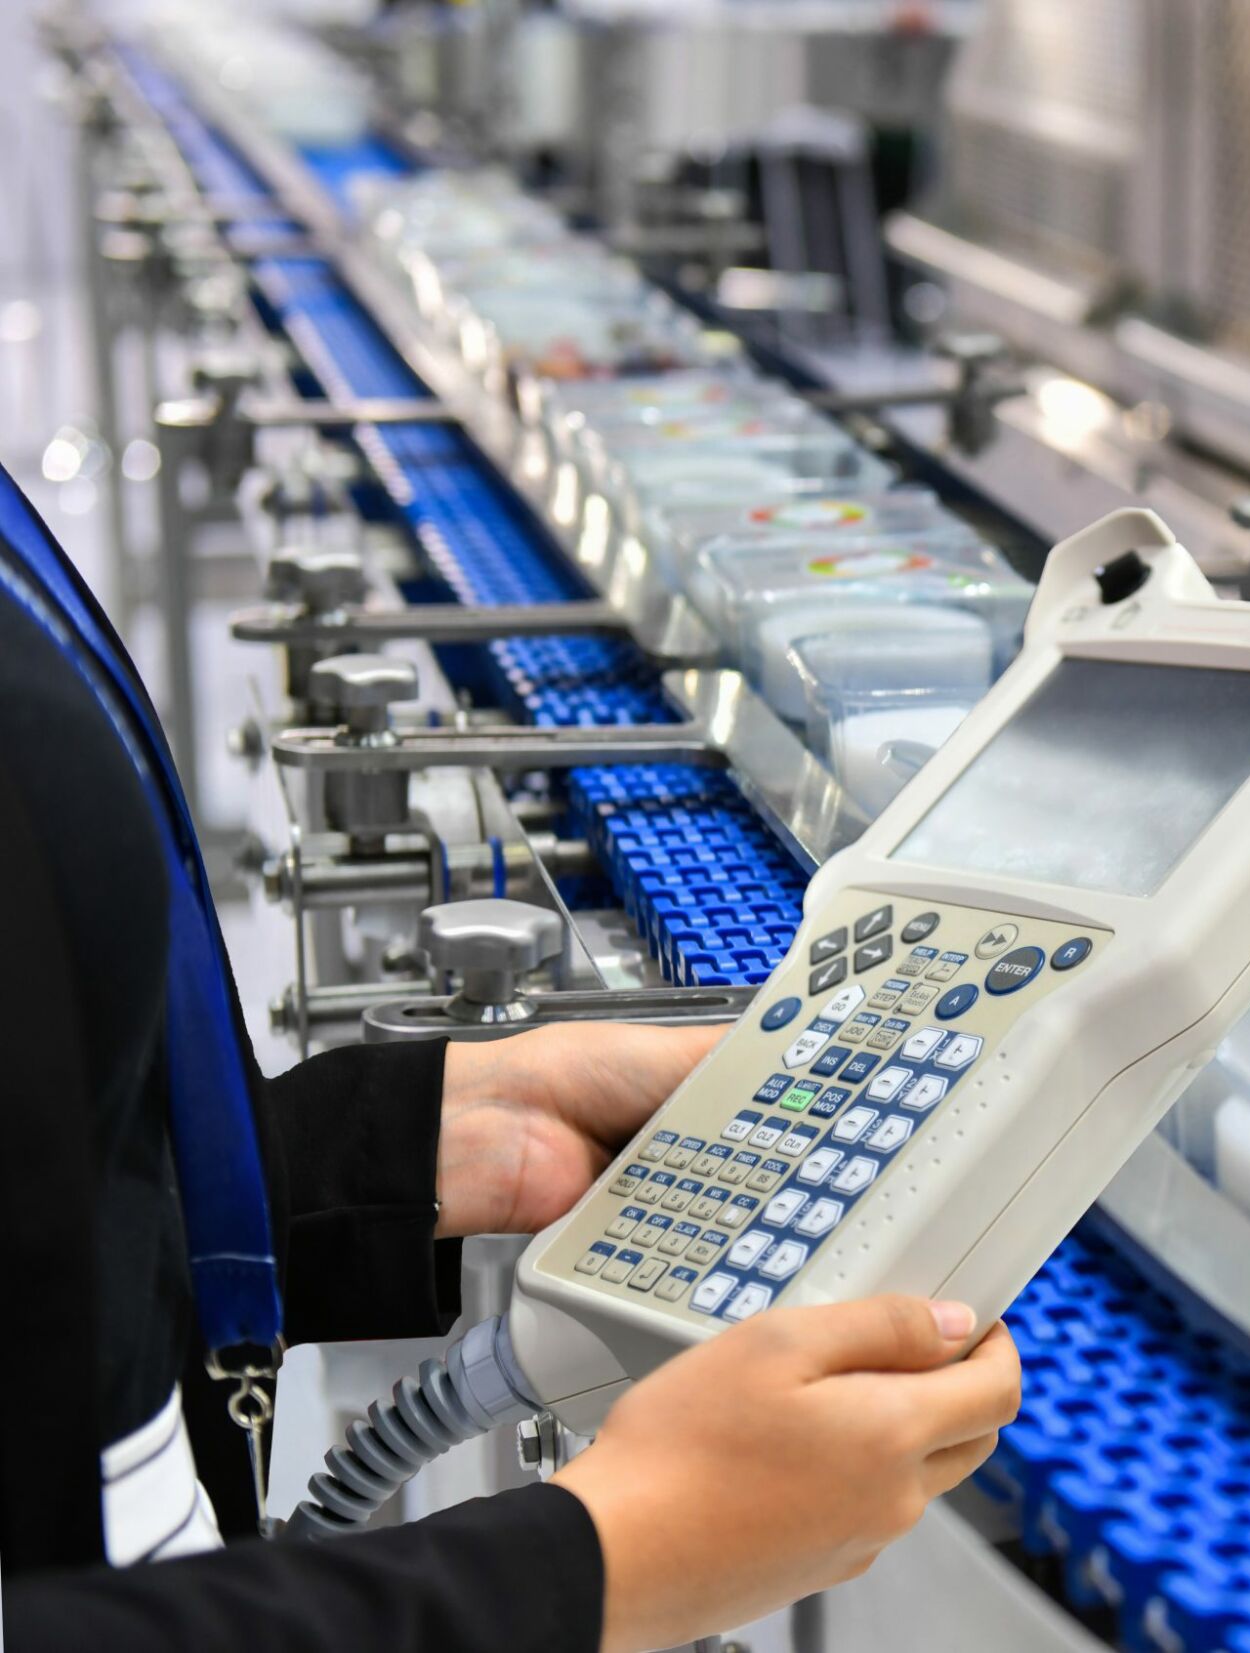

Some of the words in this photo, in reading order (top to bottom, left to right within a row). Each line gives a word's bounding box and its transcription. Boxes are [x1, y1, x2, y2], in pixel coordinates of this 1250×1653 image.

[1064, 947, 1077, 958] R
[994, 961, 1032, 977] ENTER
[872, 992, 897, 1002] STEP
[948, 995, 960, 1006] A
[831, 1002, 846, 1012] GO
[773, 1007, 785, 1019] A
[812, 1022, 835, 1033] CHECK
[845, 1026, 865, 1036] JOG
[796, 1038, 819, 1049] BACK
[943, 1038, 951, 1048] 1
[821, 1056, 838, 1066] INS
[850, 1062, 868, 1073] DEL
[766, 1079, 787, 1088] AUX
[904, 1078, 918, 1088] 2
[759, 1087, 779, 1098] MOD
[787, 1092, 808, 1104] REC
[822, 1092, 844, 1103] POS
[814, 1101, 836, 1113] MOD
[728, 1123, 746, 1135] CL1
[756, 1130, 775, 1142] CL2
[784, 1137, 802, 1149] CLn
[709, 1146, 727, 1156] ACC
[735, 1153, 757, 1164] TIMER
[616, 1177, 635, 1188] HOLD
[626, 1209, 637, 1218] ON
[651, 1217, 666, 1226] OFF
[702, 1231, 724, 1243] WORK
